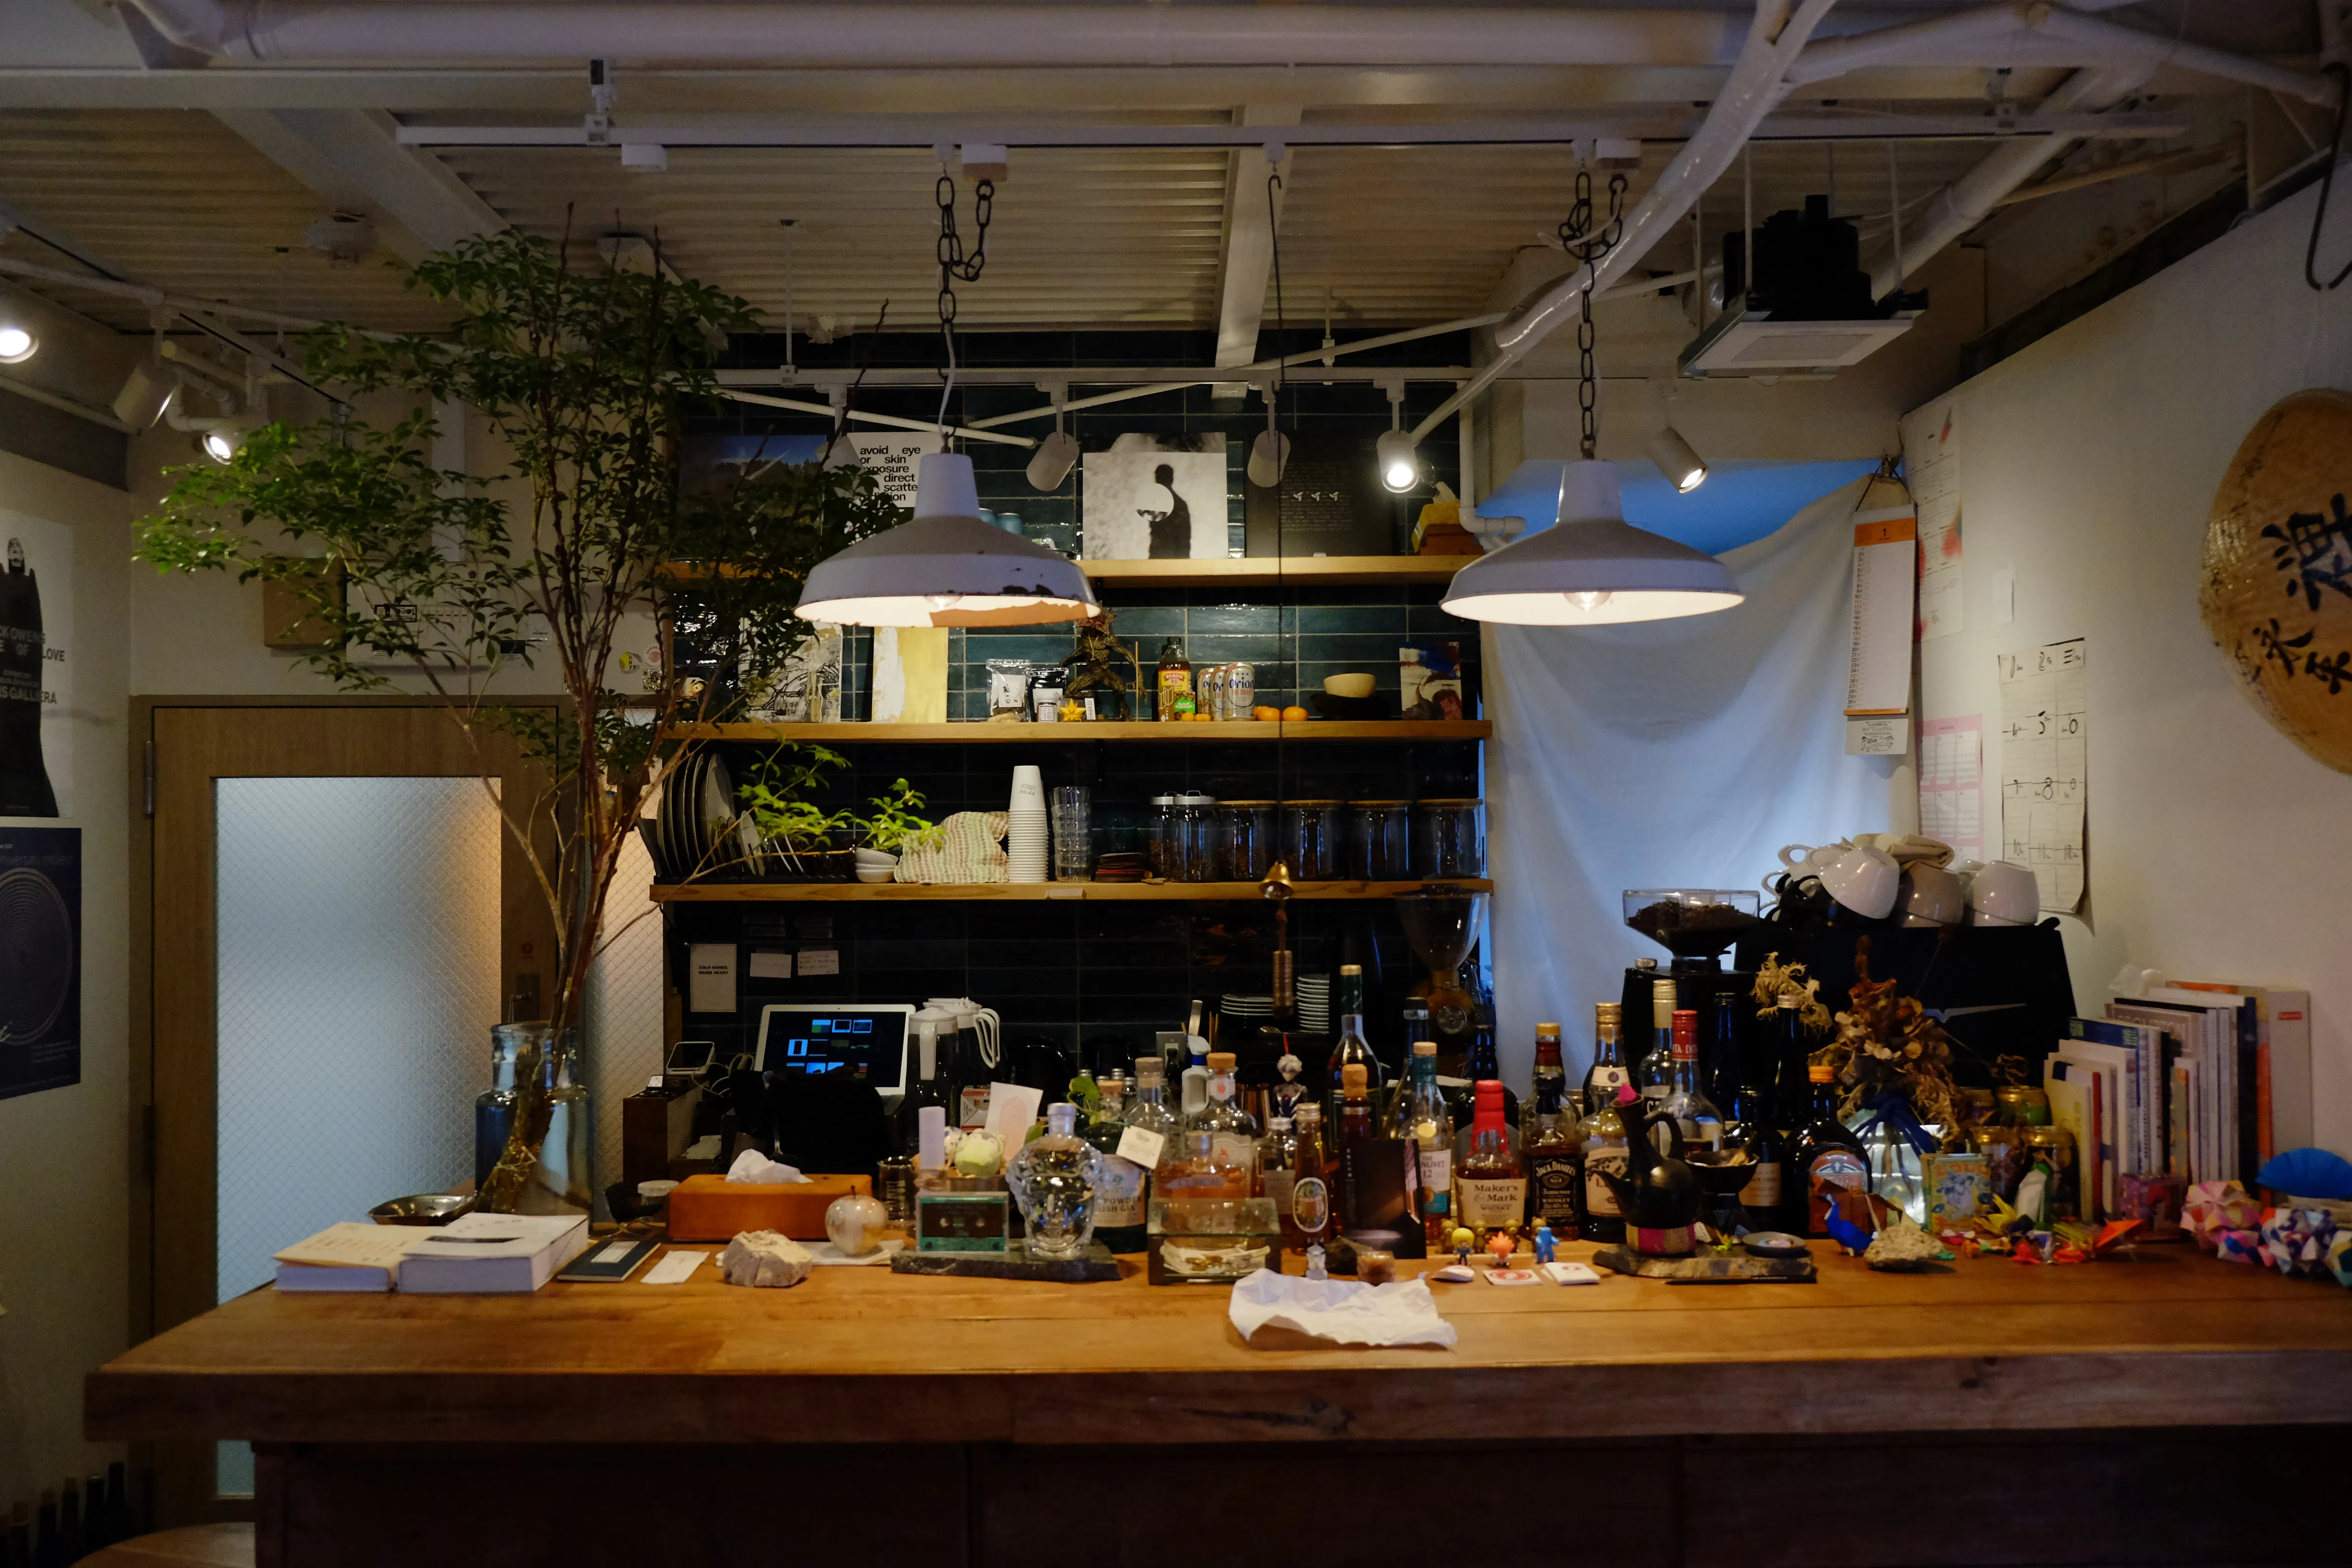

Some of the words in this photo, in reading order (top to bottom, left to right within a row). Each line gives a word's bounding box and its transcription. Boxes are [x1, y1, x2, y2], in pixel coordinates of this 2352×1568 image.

[860, 446, 888, 454] avoid
[902, 447, 920, 456] eye
[884, 455, 906, 464] skin
[884, 473, 915, 482] direct
[884, 483, 918, 491] scatte
[41, 648, 65, 662] LOVE
[1229, 679, 1254, 689] Orion
[1474, 1184, 1518, 1192] Maker's
[1487, 1193, 1518, 1201] Mark
